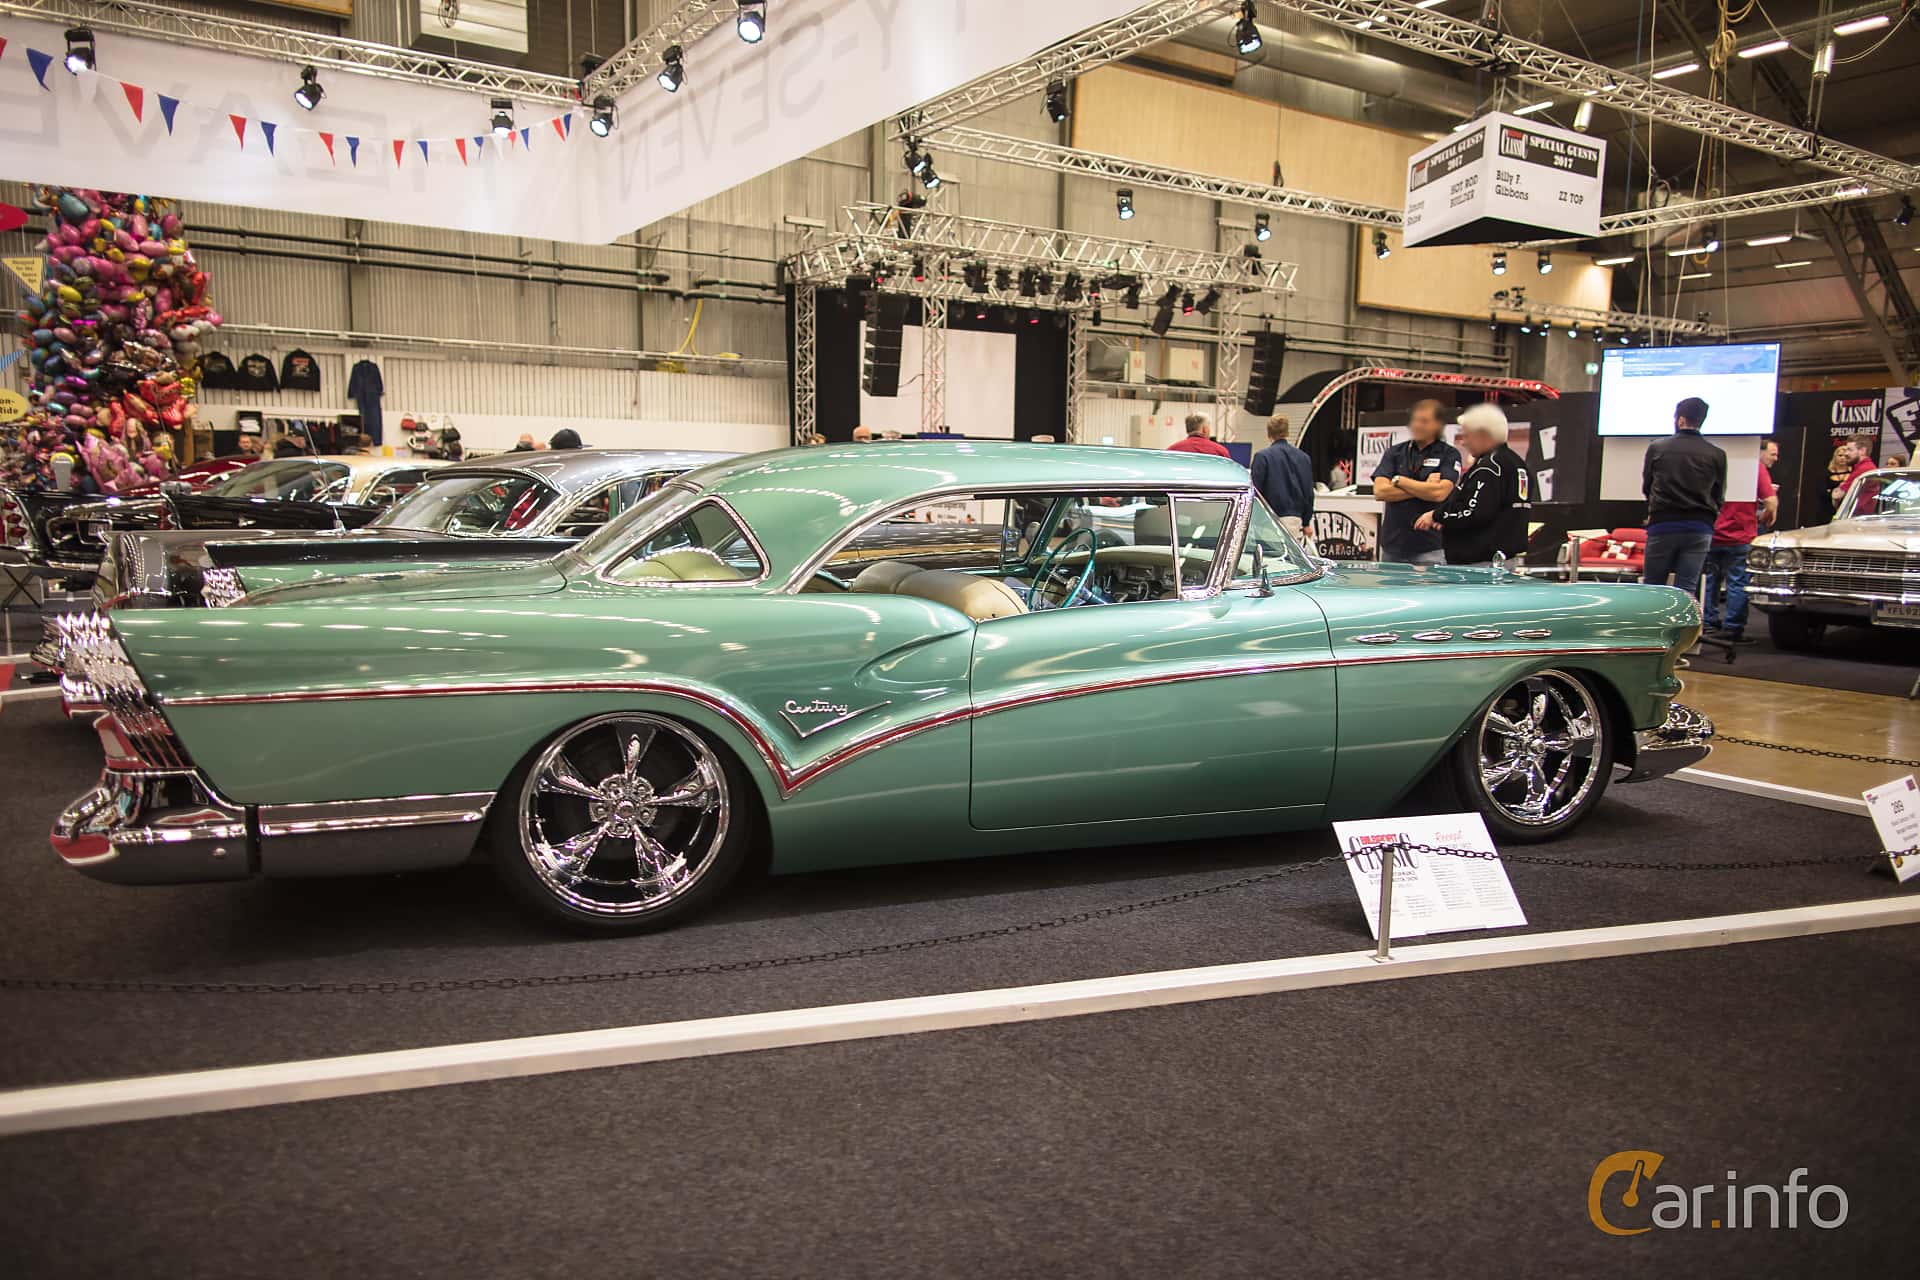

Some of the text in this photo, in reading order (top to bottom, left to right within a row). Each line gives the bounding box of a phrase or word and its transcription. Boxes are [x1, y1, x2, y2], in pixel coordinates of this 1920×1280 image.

[1529, 137, 1598, 162] SPECIAL GUESTS
[1553, 155, 1573, 169] 2017
[1497, 170, 1513, 185] Billy
[1495, 185, 1529, 200] Gibbons
[1558, 191, 1584, 205] ZZ TOP
[1832, 398, 1882, 425] CLASSIC
[1830, 426, 1880, 436] SPECIAL GUEST
[785, 699, 848, 715] Century
[1349, 832, 1419, 873] CLASIC
